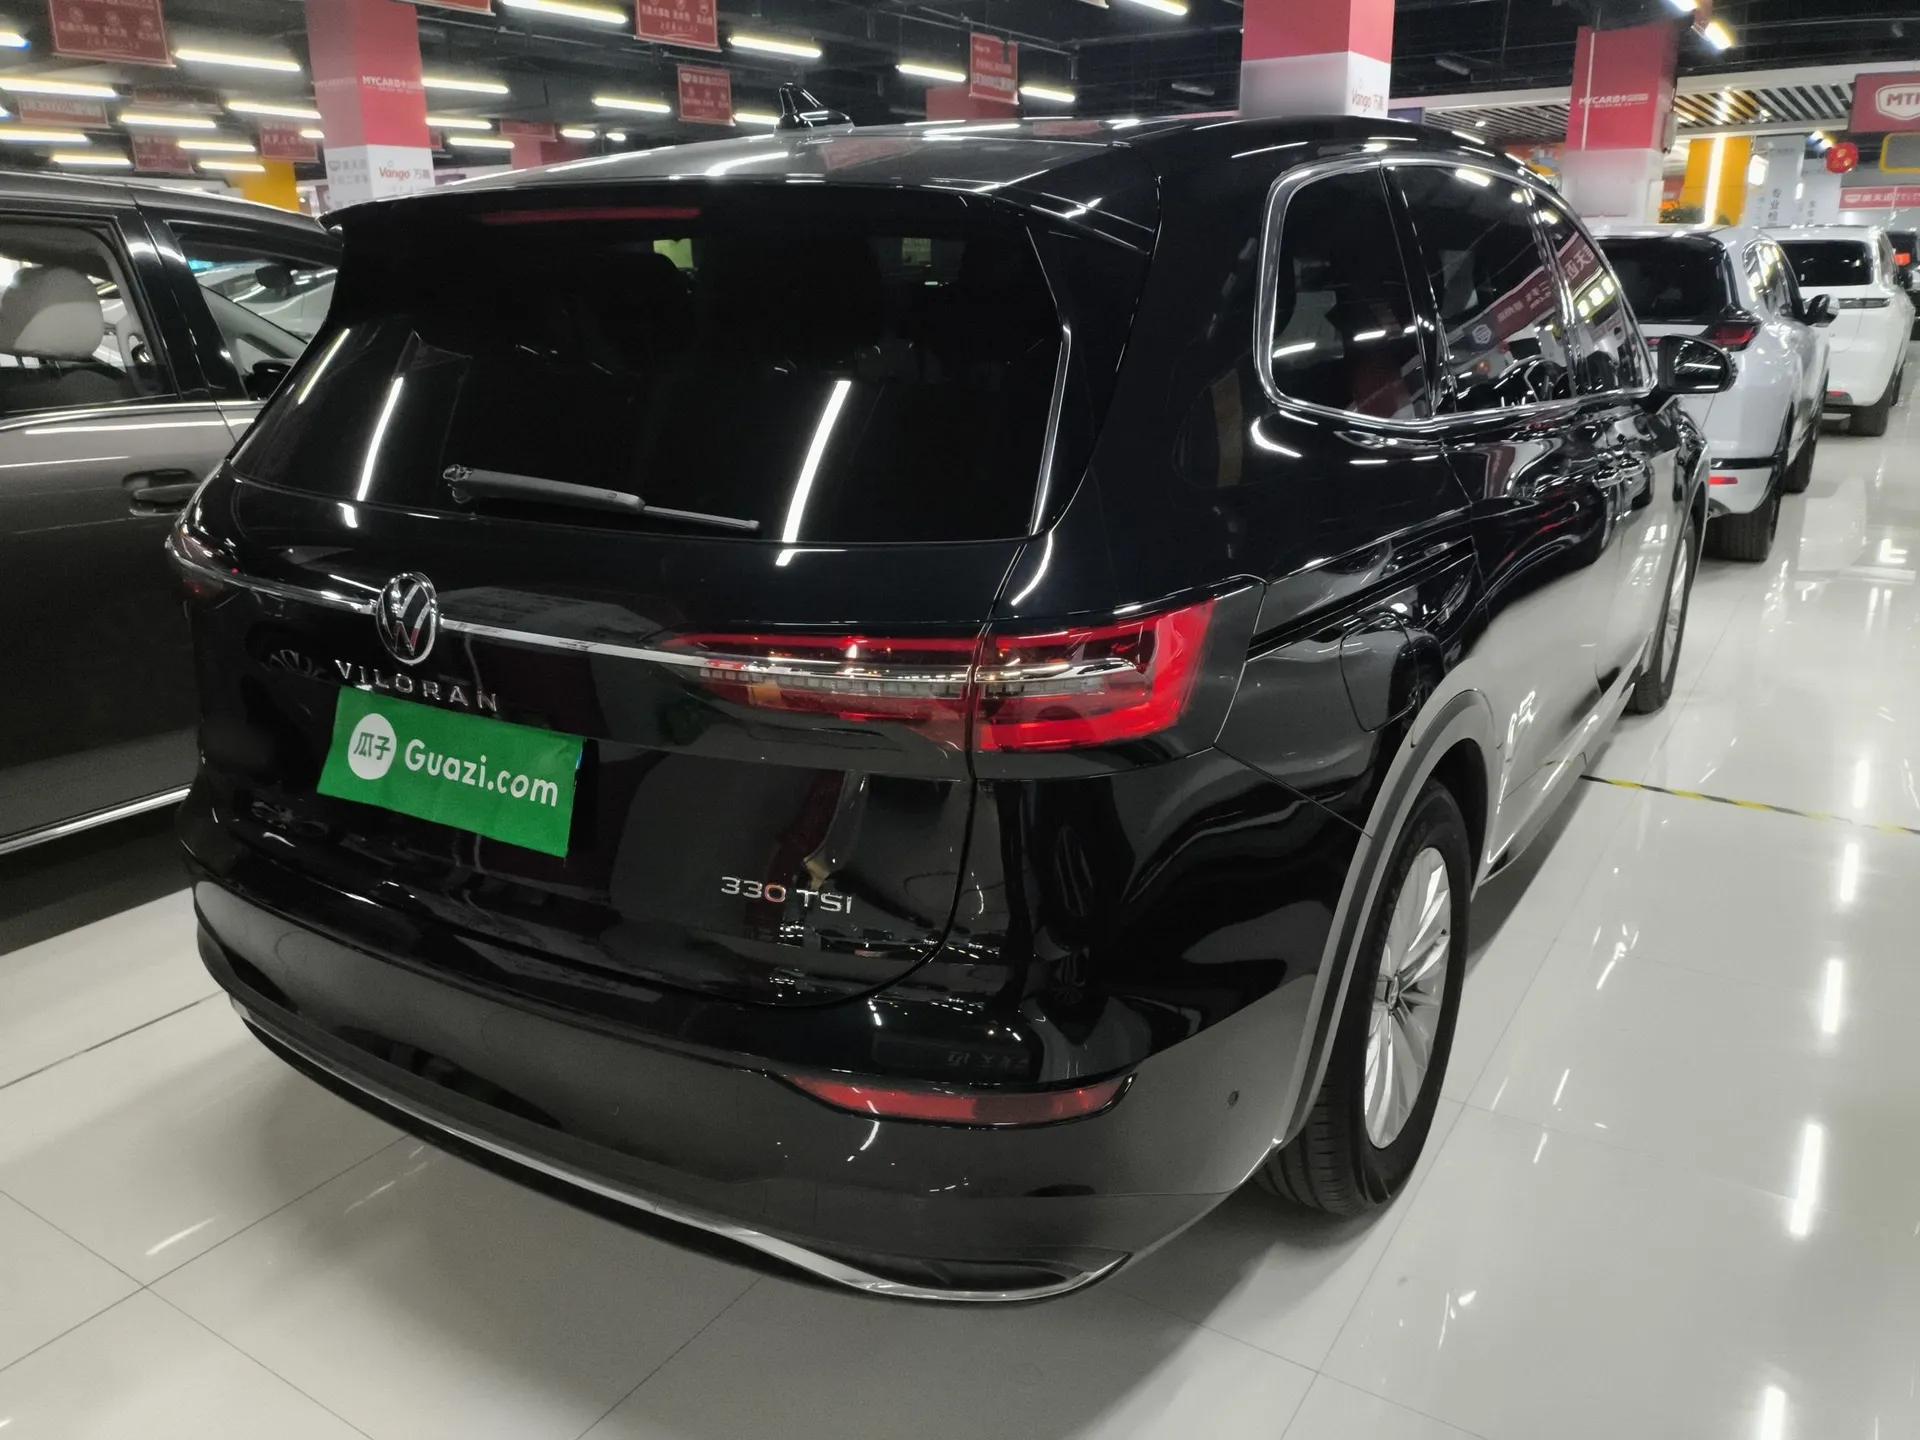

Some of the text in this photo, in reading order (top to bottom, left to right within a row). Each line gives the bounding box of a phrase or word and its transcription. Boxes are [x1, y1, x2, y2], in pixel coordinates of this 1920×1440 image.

[1887, 93, 1920, 106] MT
[379, 166, 410, 180] Vango
[335, 659, 497, 712] VILORAN
[353, 732, 391, 760] 瓜子
[404, 738, 559, 807] Guazi.com
[721, 876, 852, 914] 330 TSI
